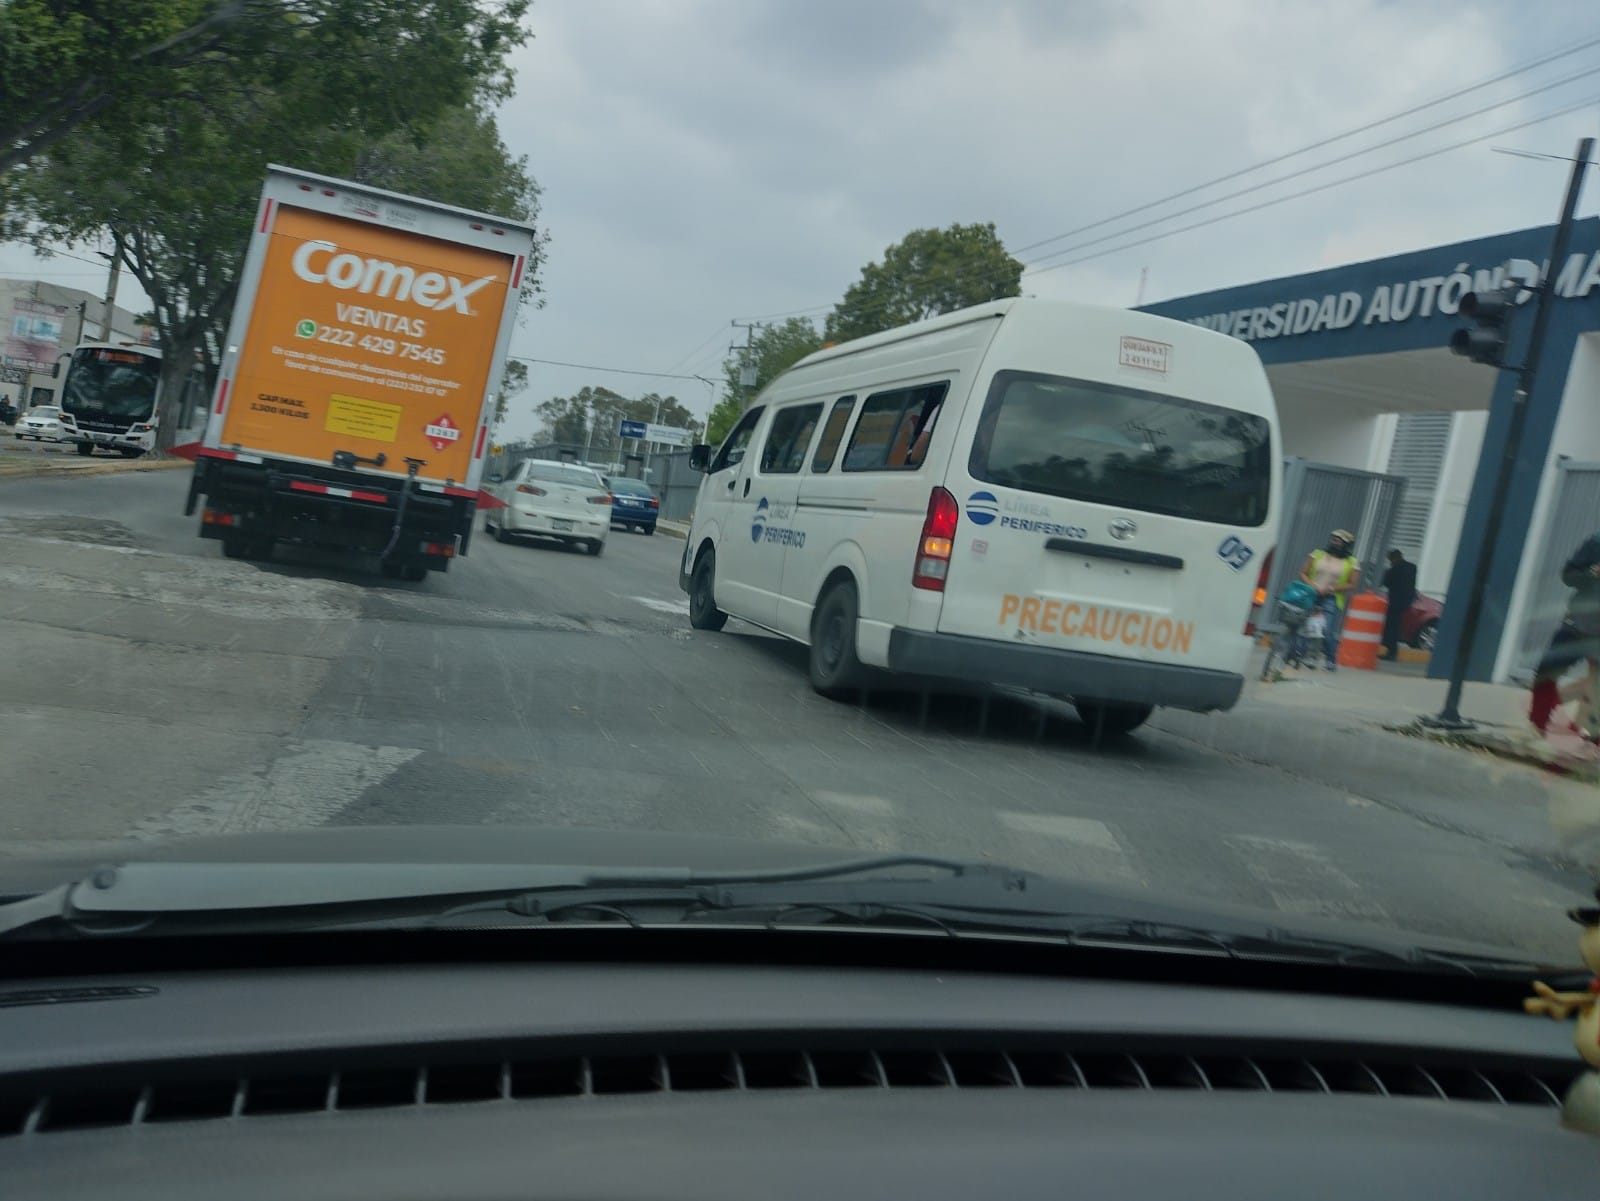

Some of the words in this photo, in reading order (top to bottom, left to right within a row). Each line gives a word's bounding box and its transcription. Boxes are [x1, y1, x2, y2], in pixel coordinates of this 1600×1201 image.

[292, 240, 497, 315] Comex
[336, 302, 426, 337] VENTAS
[1187, 290, 1363, 340] IVERSIDAD
[318, 326, 355, 348] 222
[359, 333, 395, 355] 429
[400, 341, 446, 365] 7545
[1000, 515, 1088, 539] PERIFERICO
[998, 593, 1195, 654] PRECAUCION
